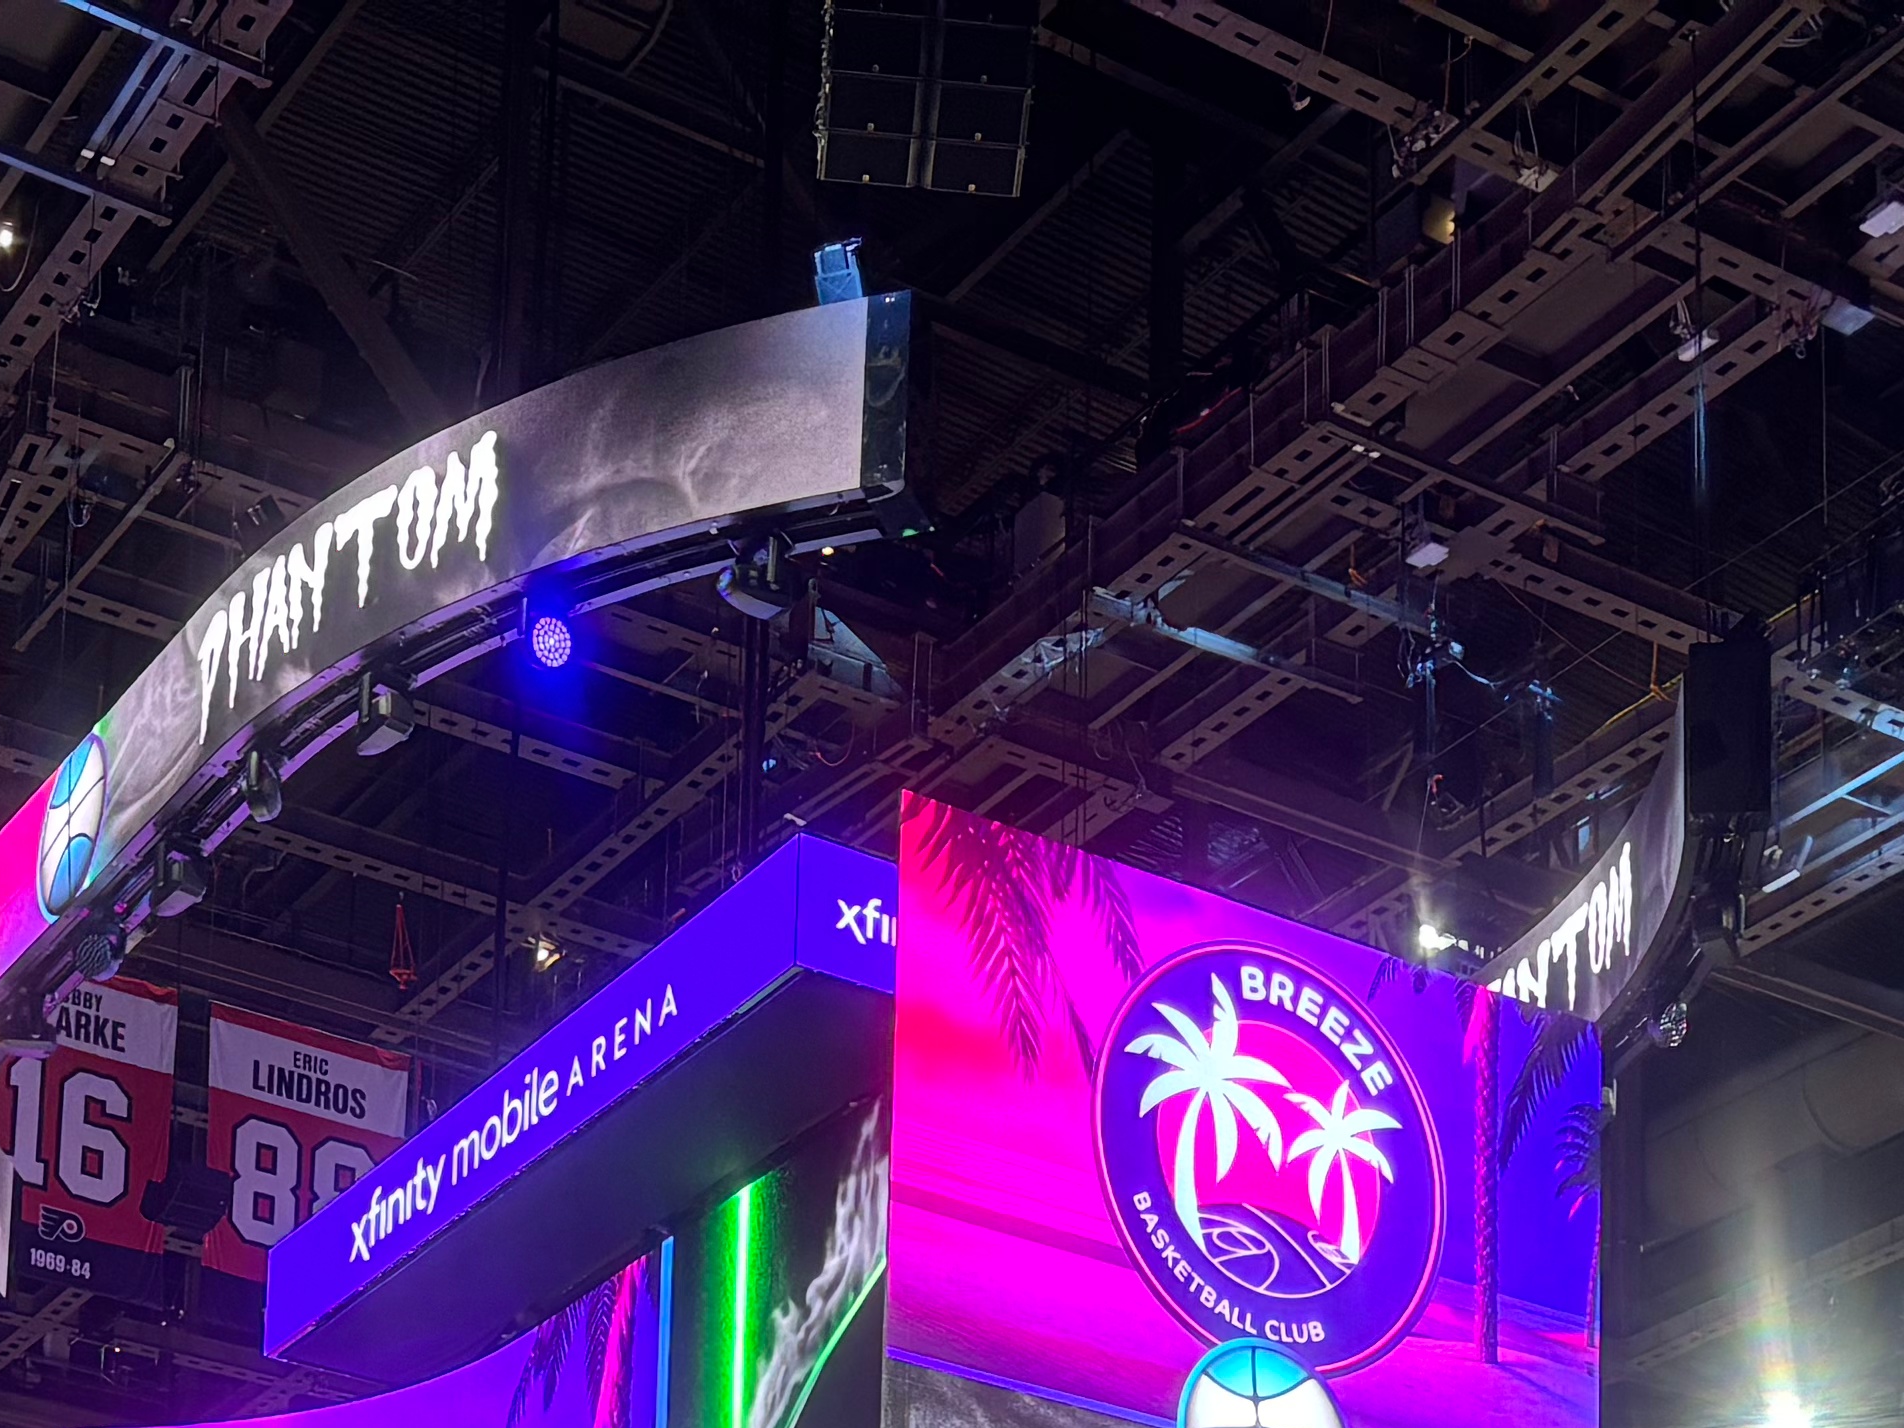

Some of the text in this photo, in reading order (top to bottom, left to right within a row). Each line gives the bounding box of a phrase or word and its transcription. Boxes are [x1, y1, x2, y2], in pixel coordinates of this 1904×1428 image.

[197, 431, 499, 745] PHANTOM
[56, 1003, 127, 1053] ARKE
[252, 1059, 367, 1120] LINDROS
[293, 1051, 329, 1077] ERIC
[1238, 965, 1393, 1097] BREEZE
[10, 1059, 129, 1204] 16
[349, 983, 677, 1263] xfinity mobile ARENA
[30, 1248, 91, 1280] 1969-84
[1133, 1191, 1326, 1345] BASKETBALL CLUB
